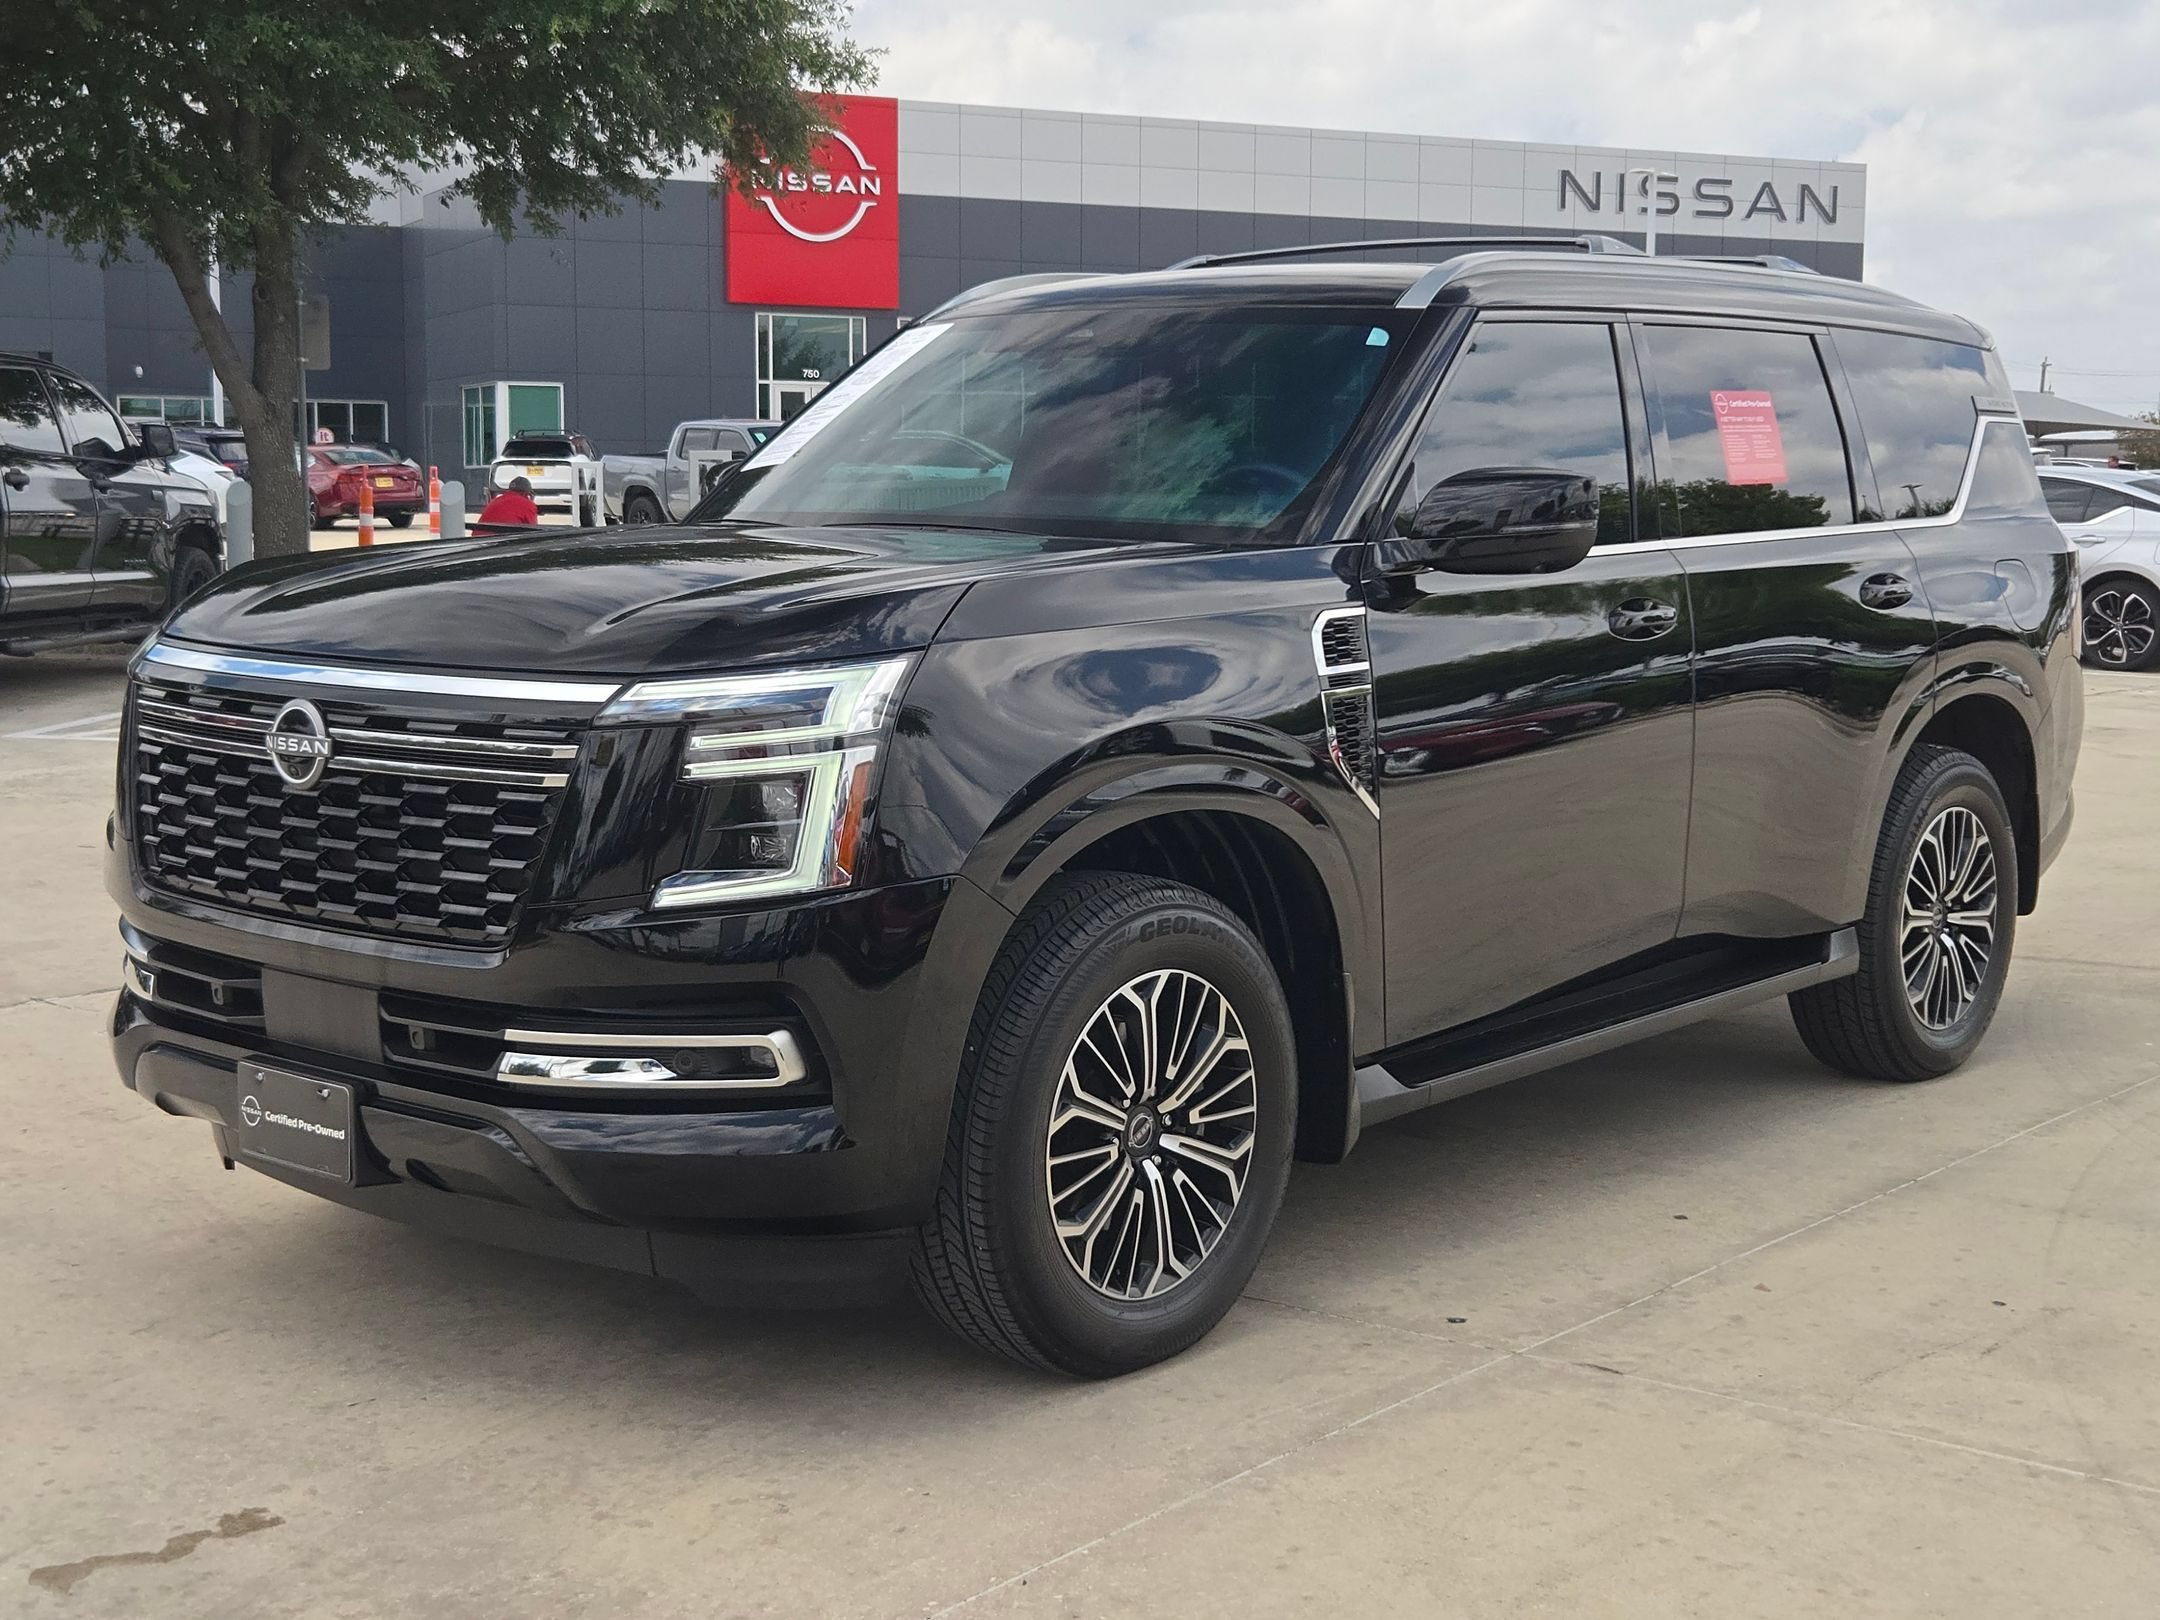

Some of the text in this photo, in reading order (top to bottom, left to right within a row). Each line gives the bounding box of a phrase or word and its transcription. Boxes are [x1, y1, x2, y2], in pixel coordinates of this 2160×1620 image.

[1558, 169, 1838, 225] NISSAN
[802, 369, 820, 379] 750
[266, 735, 329, 755] NISSAN
[265, 1110, 298, 1129] Certified
[298, 1119, 345, 1140] Pre-Owned
